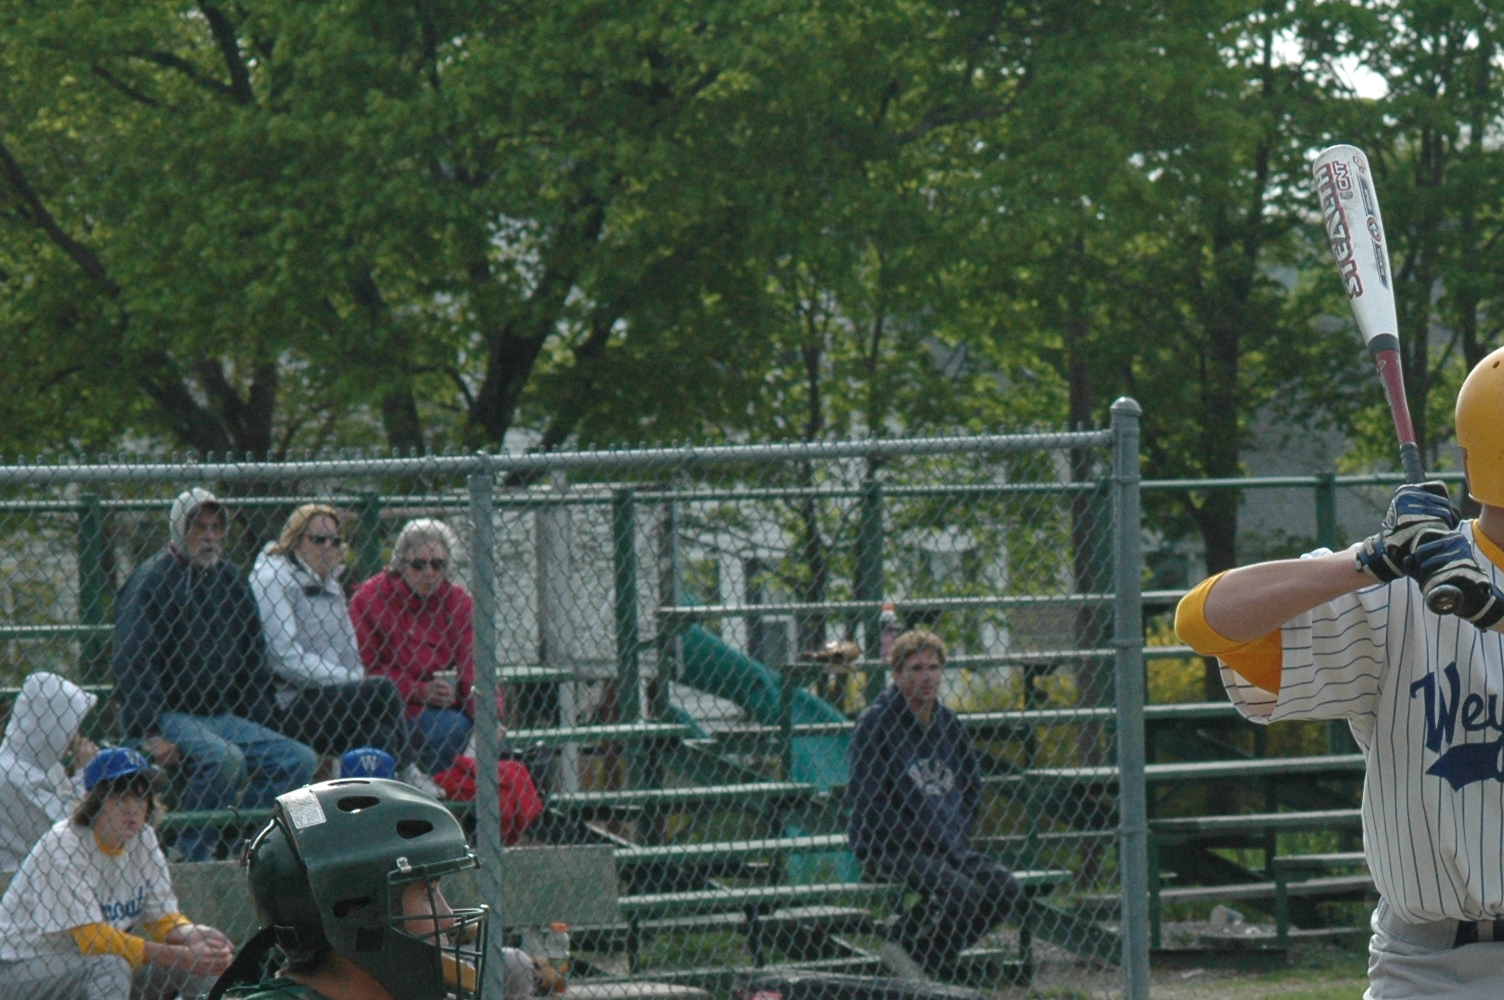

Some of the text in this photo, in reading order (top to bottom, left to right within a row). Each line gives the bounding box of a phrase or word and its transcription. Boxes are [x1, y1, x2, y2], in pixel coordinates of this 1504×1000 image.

[1333, 160, 1354, 190] CNT
[1315, 162, 1363, 299] STEALTH
[361, 755, 377, 771] W
